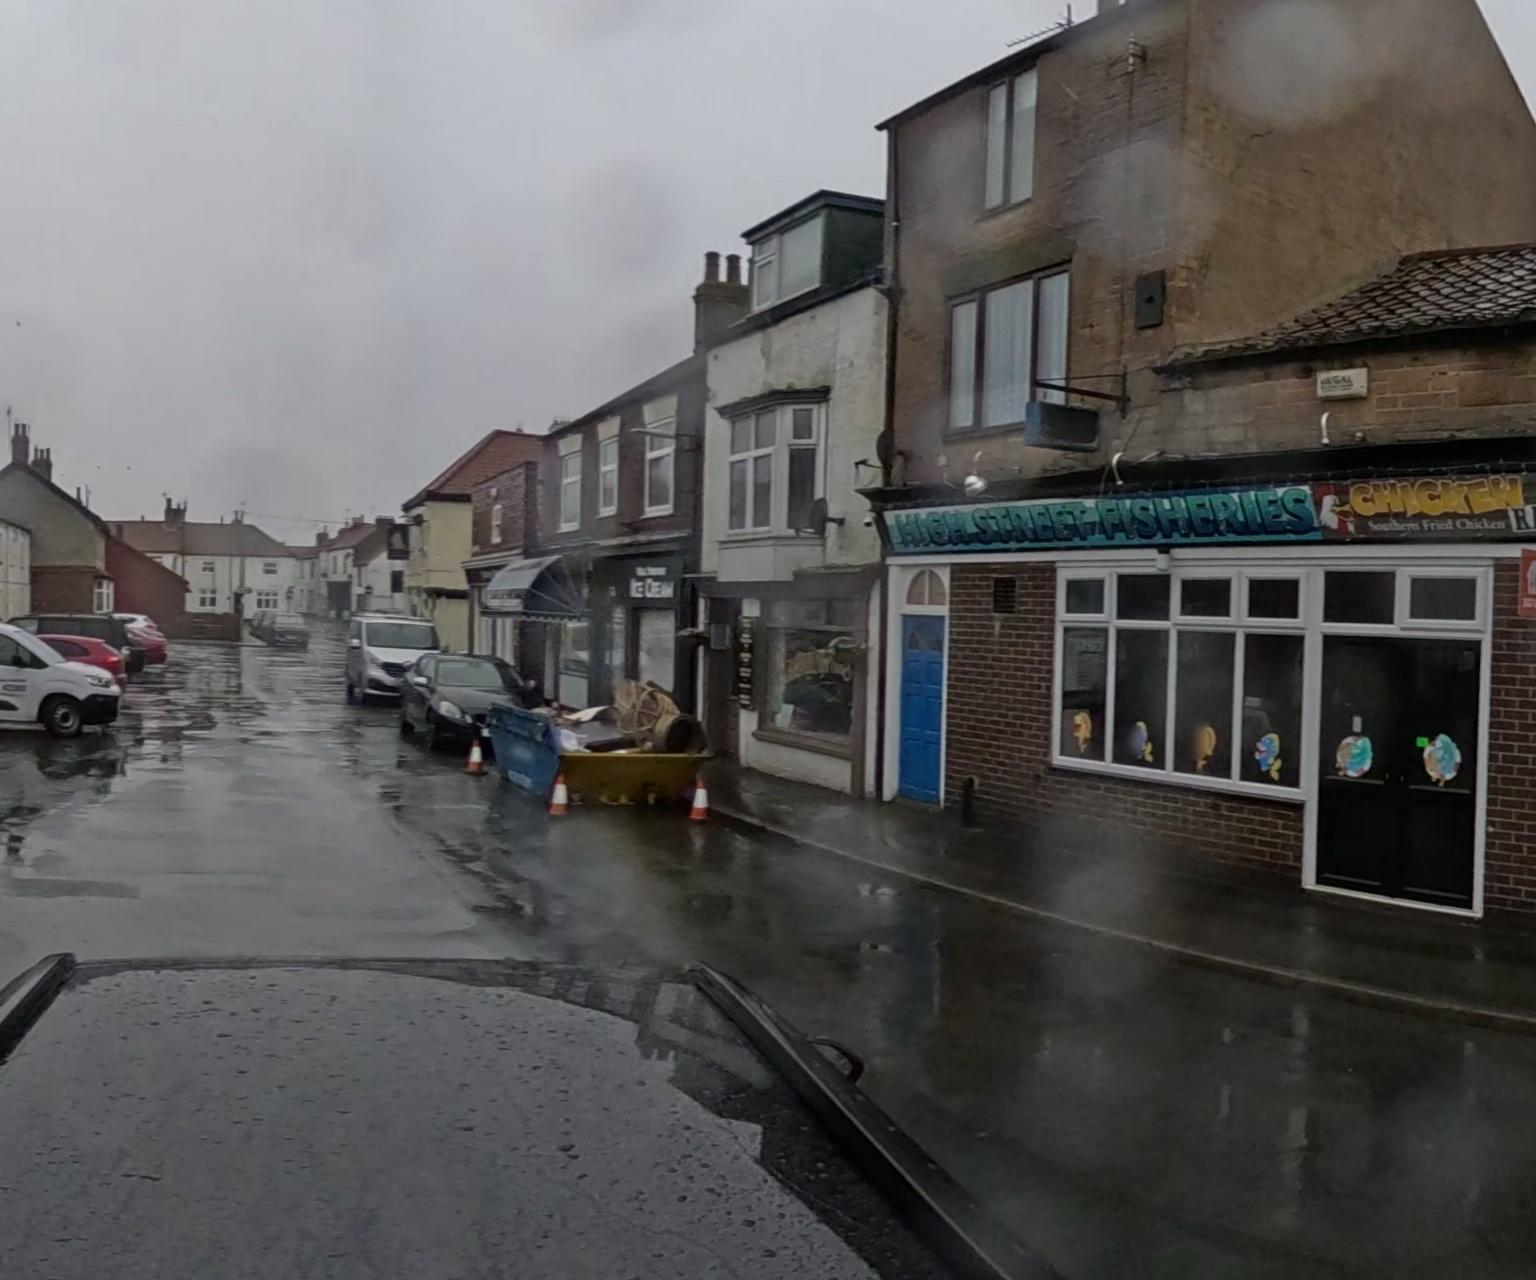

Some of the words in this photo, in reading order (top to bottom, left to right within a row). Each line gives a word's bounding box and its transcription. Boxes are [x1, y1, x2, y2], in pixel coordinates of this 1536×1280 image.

[1350, 476, 1525, 517] CHICKEN
[894, 510, 970, 548] HIGH
[971, 501, 1094, 545] STREET
[1095, 487, 1317, 540] FISHERIES
[1368, 519, 1421, 532] Southern
[1422, 519, 1454, 531] Fried
[1456, 518, 1505, 531] Chicken
